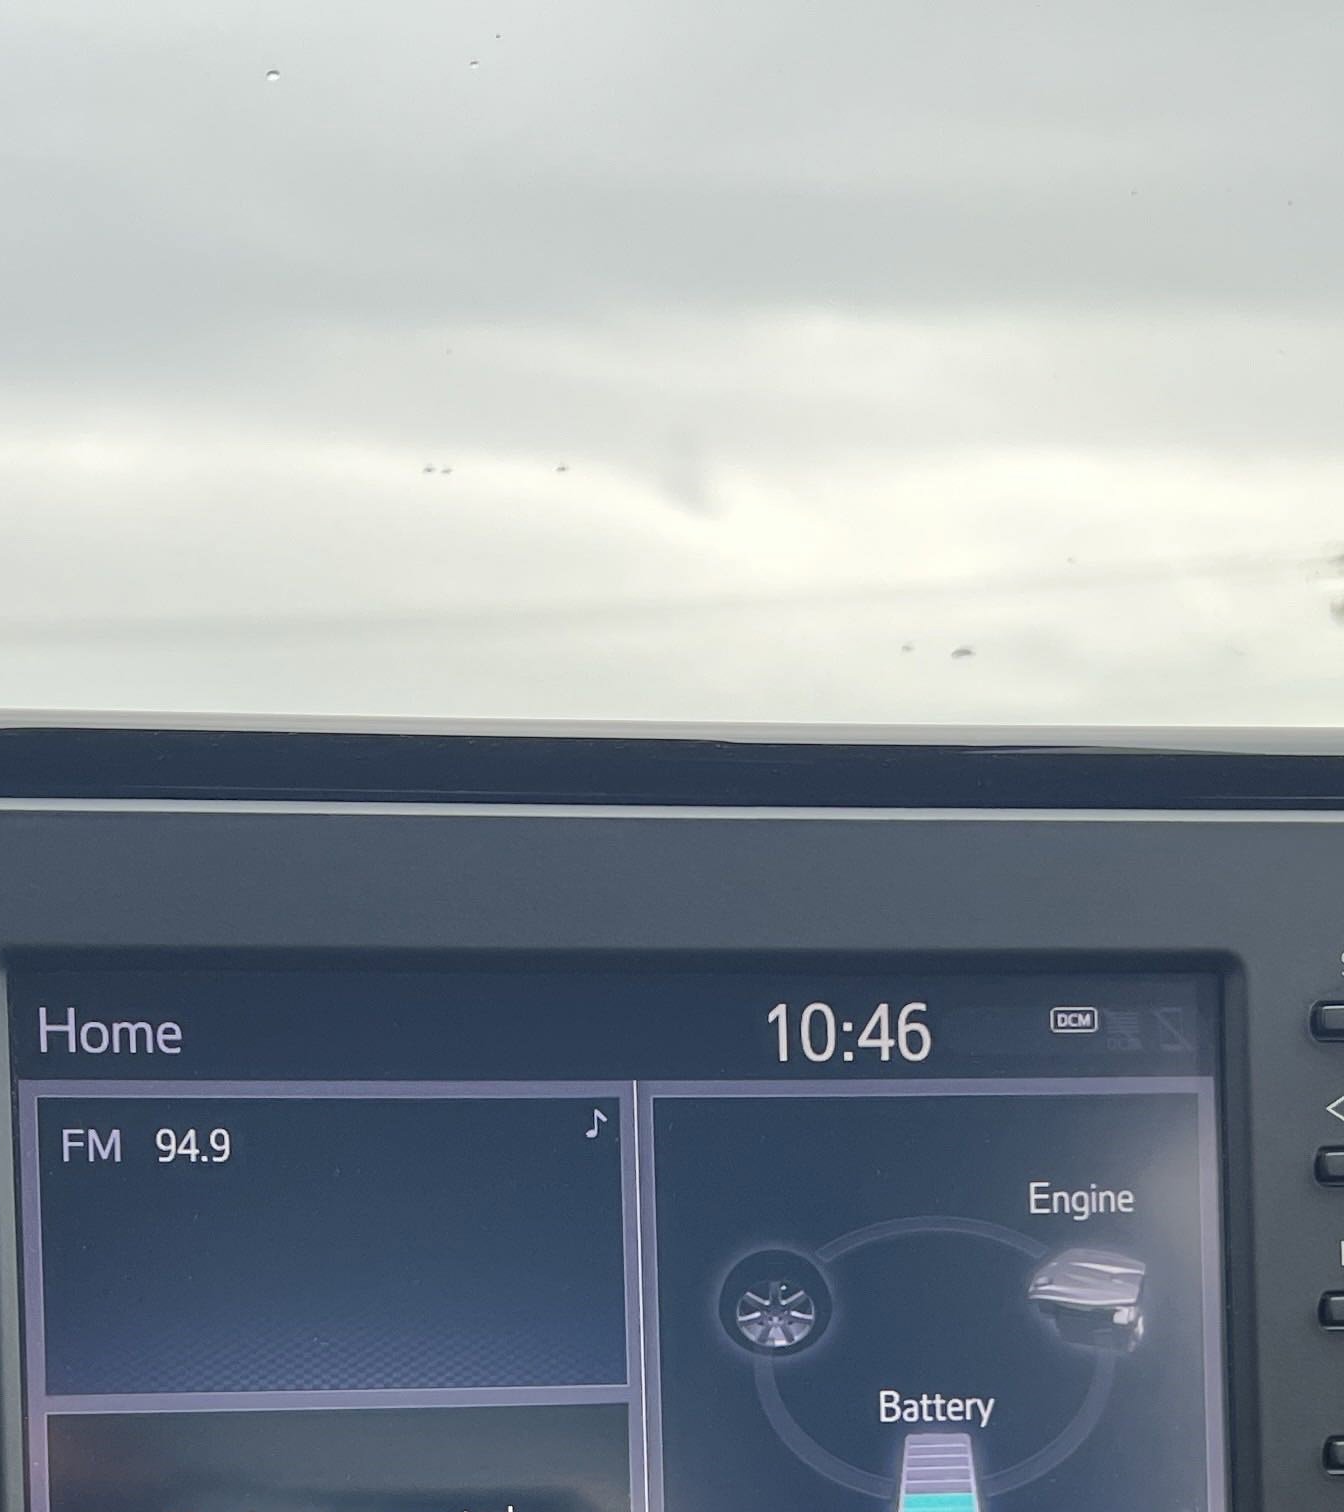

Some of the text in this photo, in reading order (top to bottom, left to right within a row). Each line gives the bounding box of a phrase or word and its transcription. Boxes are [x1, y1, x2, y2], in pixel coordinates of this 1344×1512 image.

[37, 1007, 184, 1054] Home
[766, 1002, 932, 1062] 10:46
[1057, 1013, 1091, 1028] DCM
[61, 1129, 231, 1162] FM 94.9
[1029, 1182, 1135, 1221] Engine
[879, 1391, 995, 1428] Battery
